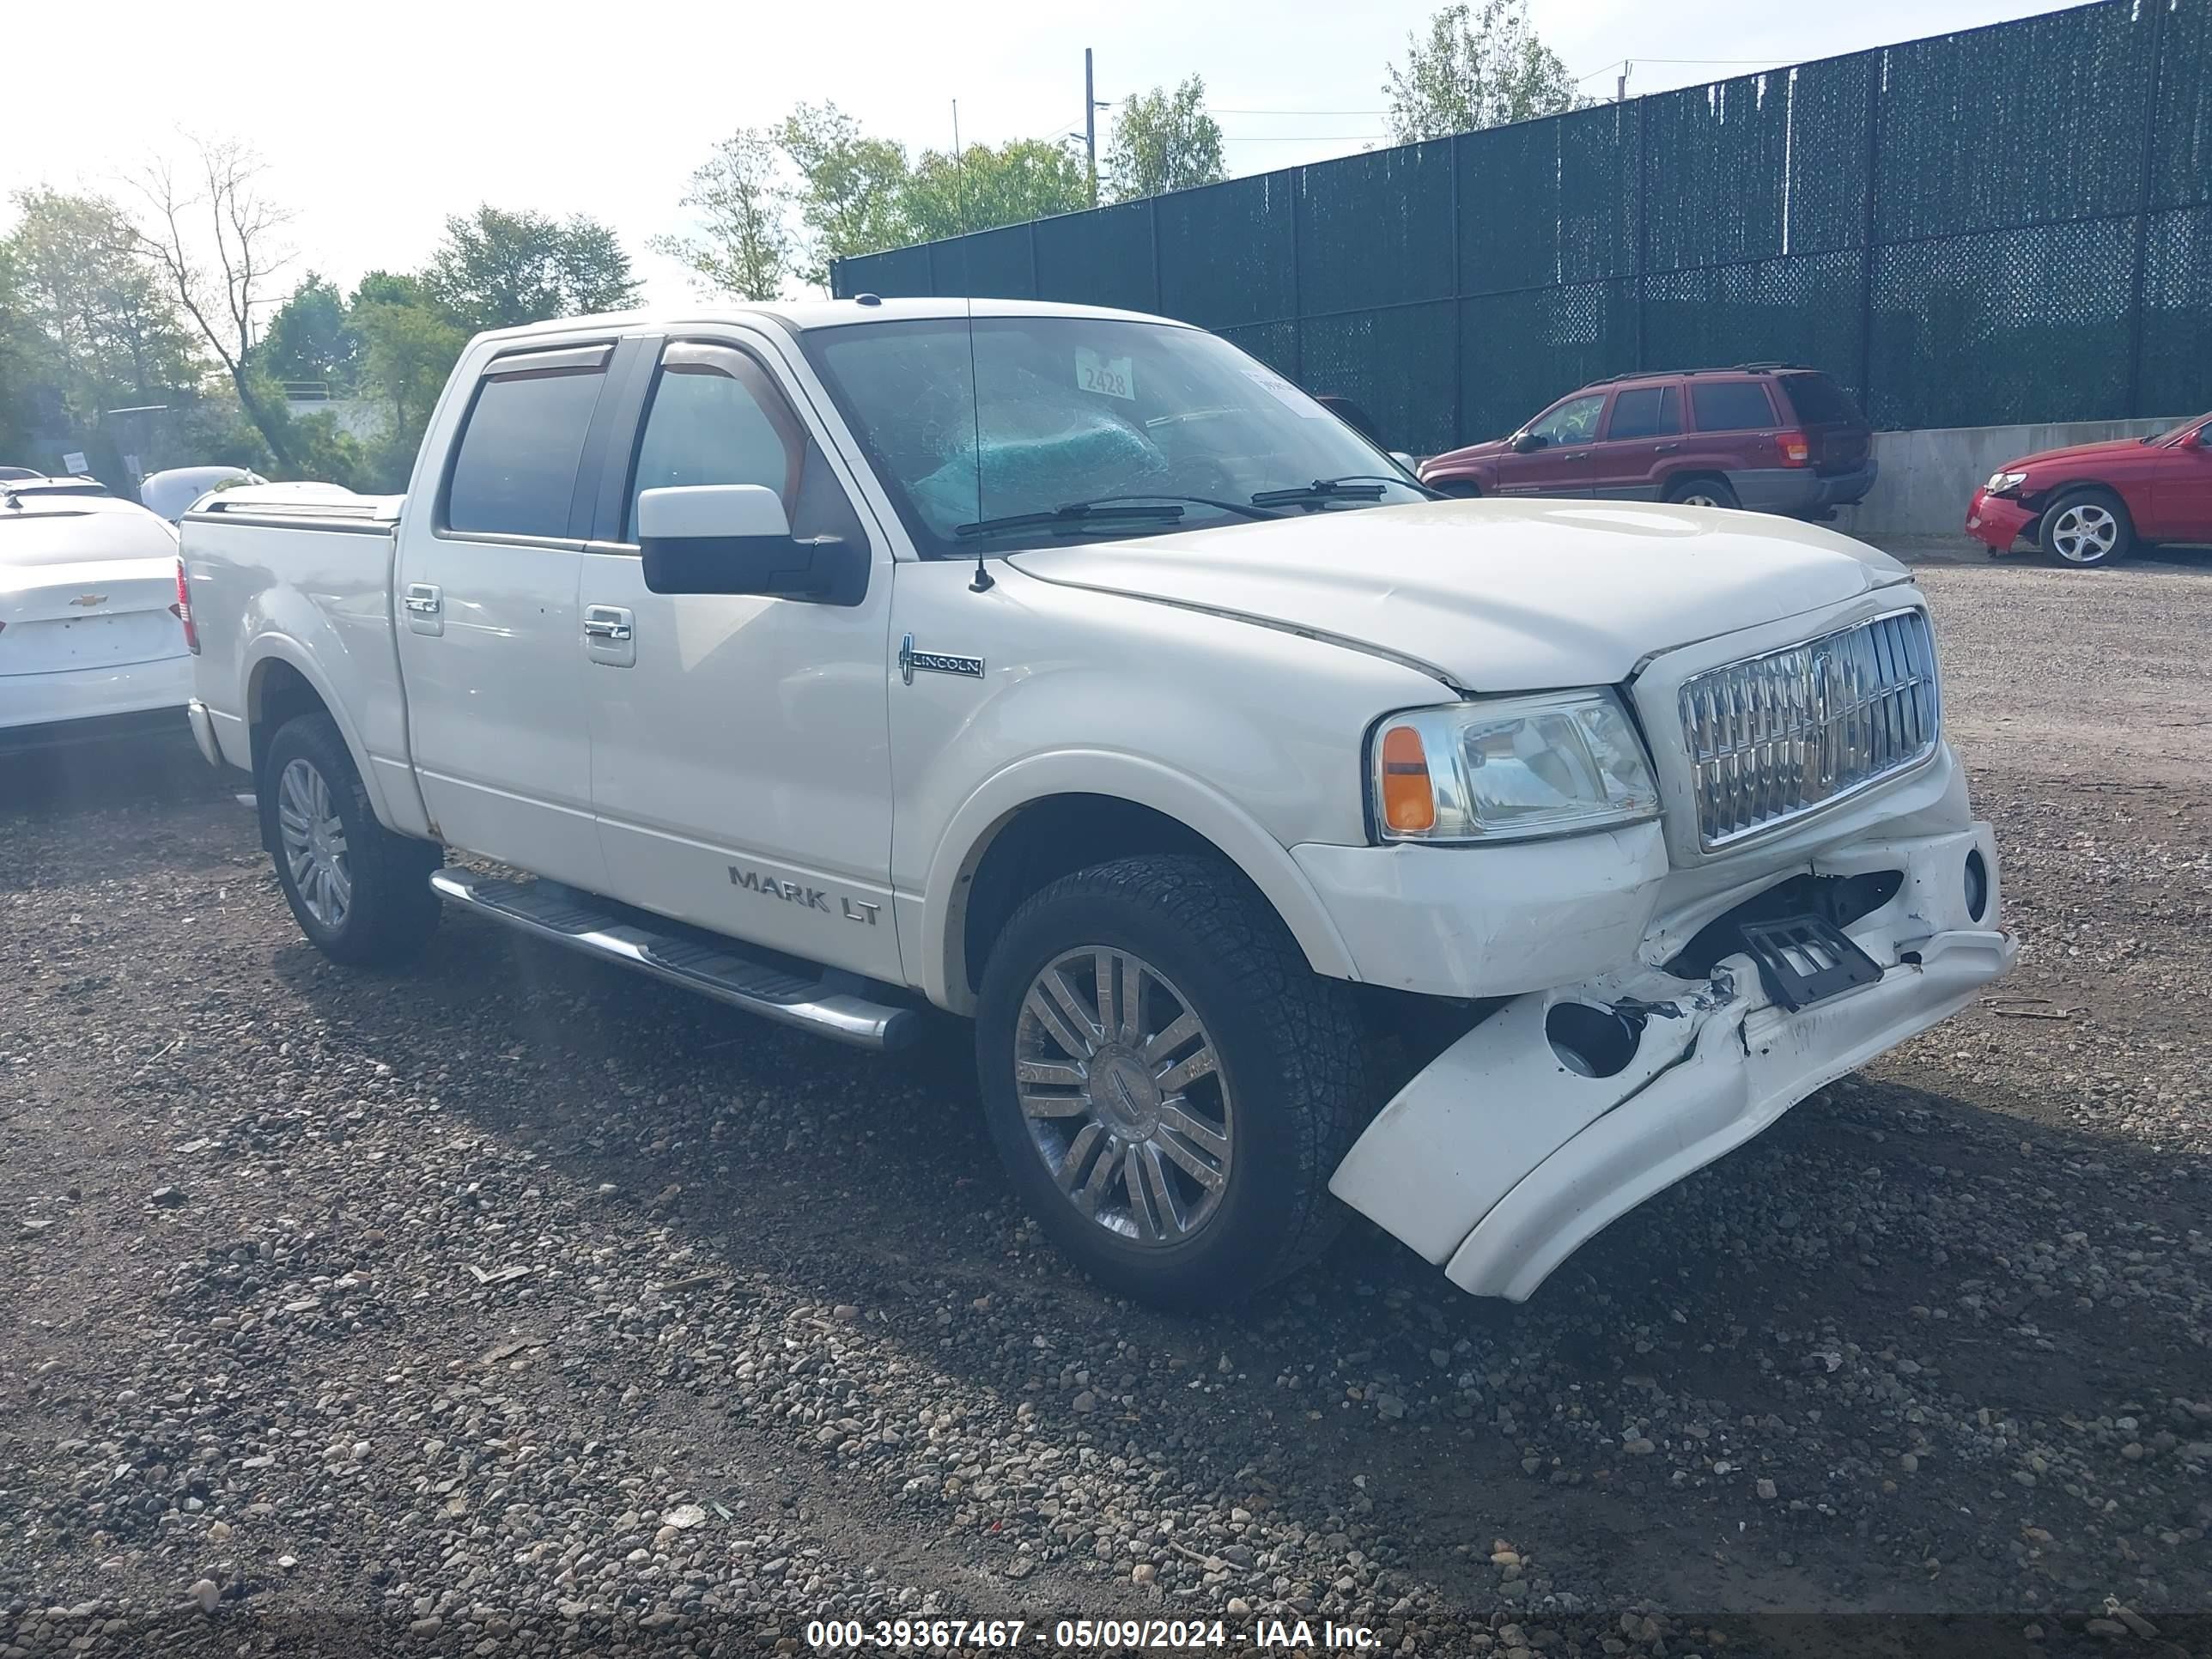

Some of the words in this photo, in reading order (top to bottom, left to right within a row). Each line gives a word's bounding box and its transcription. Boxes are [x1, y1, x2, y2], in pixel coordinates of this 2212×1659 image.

[1085, 366, 1127, 396] 2428
[913, 653, 980, 672] LINCOLN
[728, 865, 830, 914] MARK
[841, 896, 881, 926] LT
